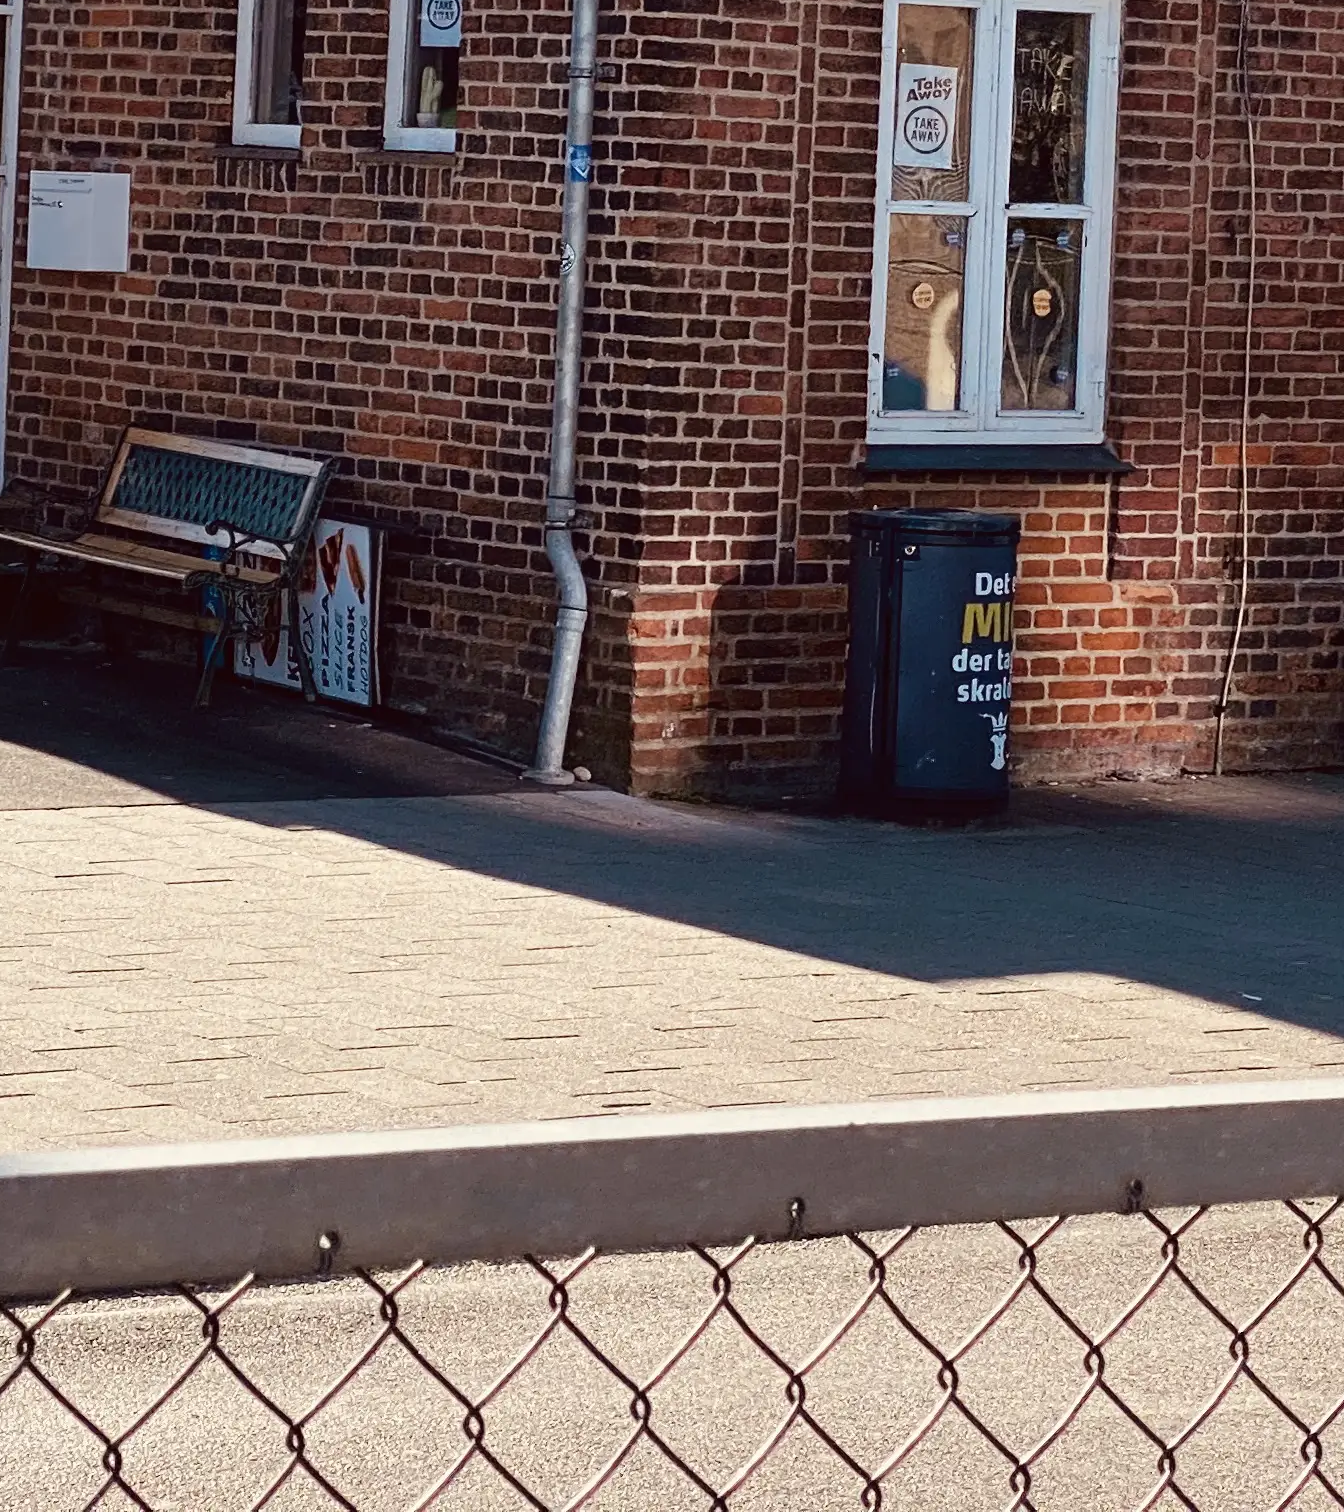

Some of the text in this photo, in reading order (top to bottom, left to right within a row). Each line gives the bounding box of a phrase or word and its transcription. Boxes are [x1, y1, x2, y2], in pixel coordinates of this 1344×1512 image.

[1017, 47, 1075, 81] TAKE
[906, 87, 953, 103] Away
[913, 76, 953, 91] Take
[911, 130, 941, 143] AWAY
[914, 117, 939, 130] TAKE
[962, 602, 1014, 644] MI
[321, 594, 330, 687] PIZZA
[334, 611, 344, 690] SLICE
[346, 605, 357, 693] FRANSK
[358, 614, 369, 695] HOTDOG
[951, 648, 1012, 673] der ta
